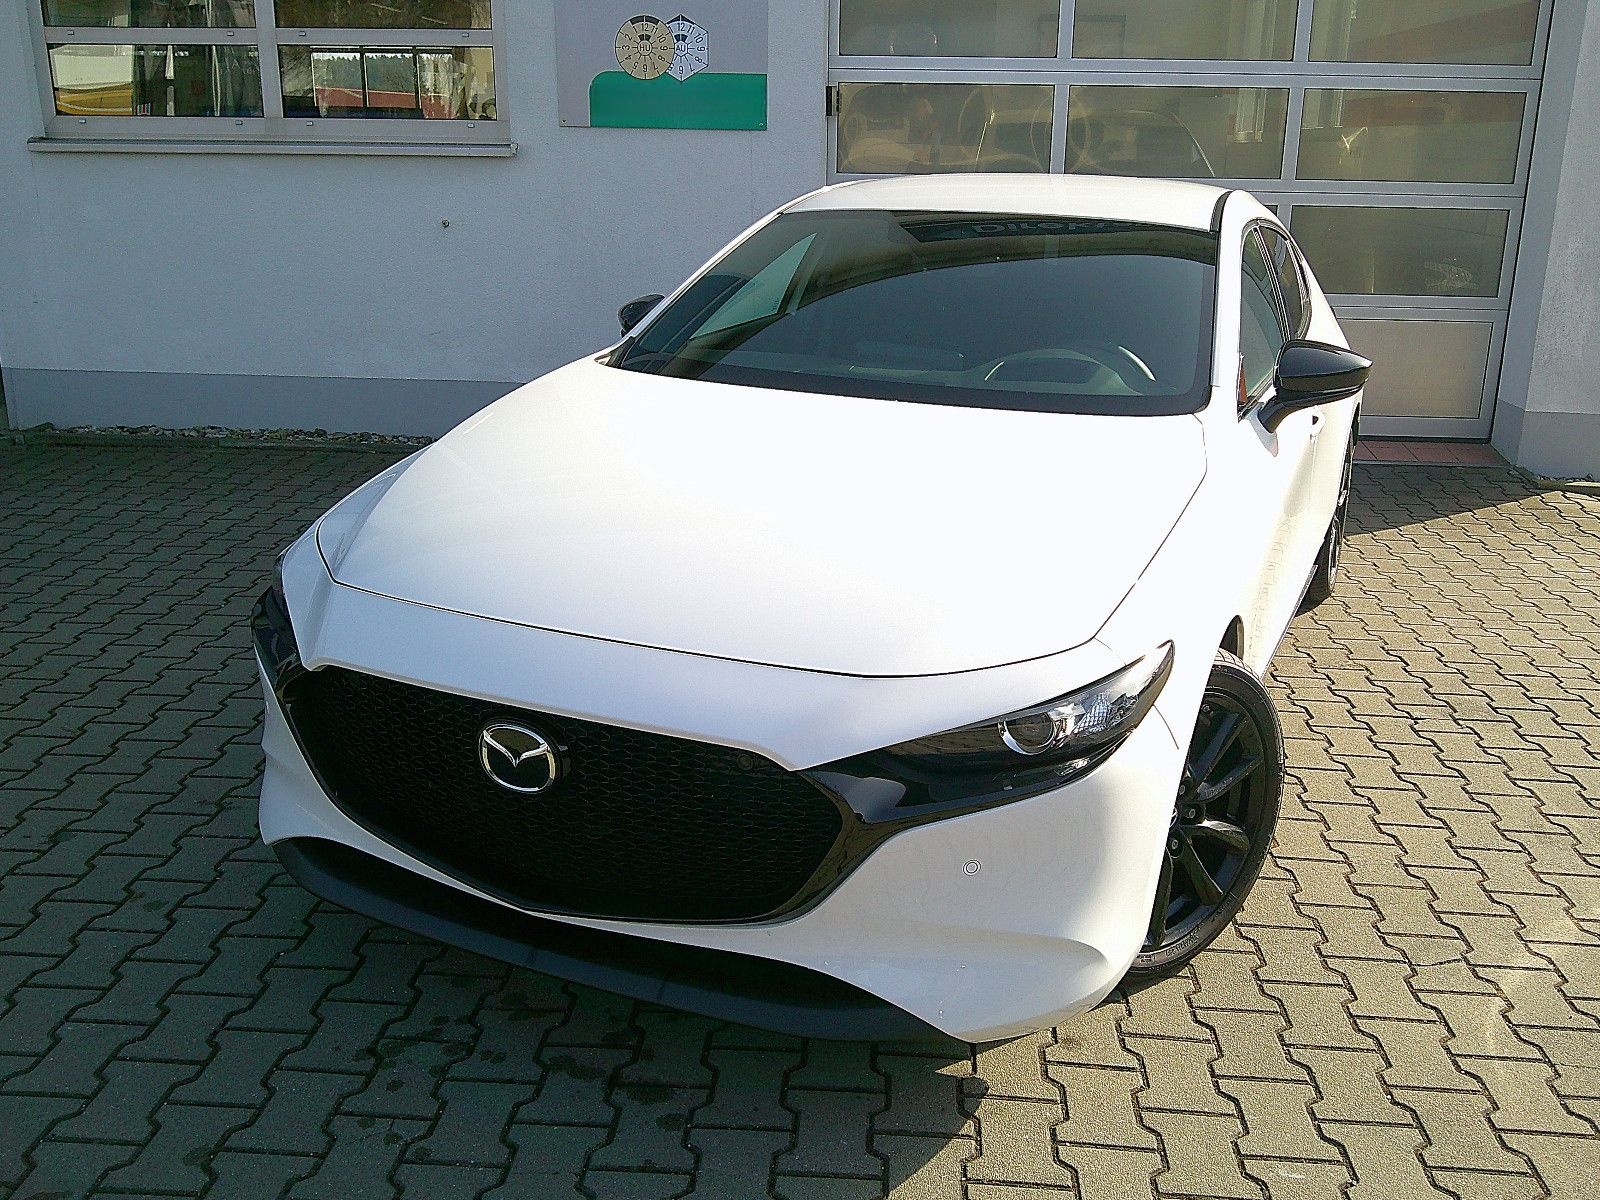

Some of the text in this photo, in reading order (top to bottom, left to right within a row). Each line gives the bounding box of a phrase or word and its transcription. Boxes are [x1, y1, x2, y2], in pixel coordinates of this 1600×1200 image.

[641, 23, 649, 31] 12
[677, 22, 685, 31] 12
[687, 25, 695, 34] 11
[657, 33, 666, 43] 10
[694, 33, 703, 43] 10
